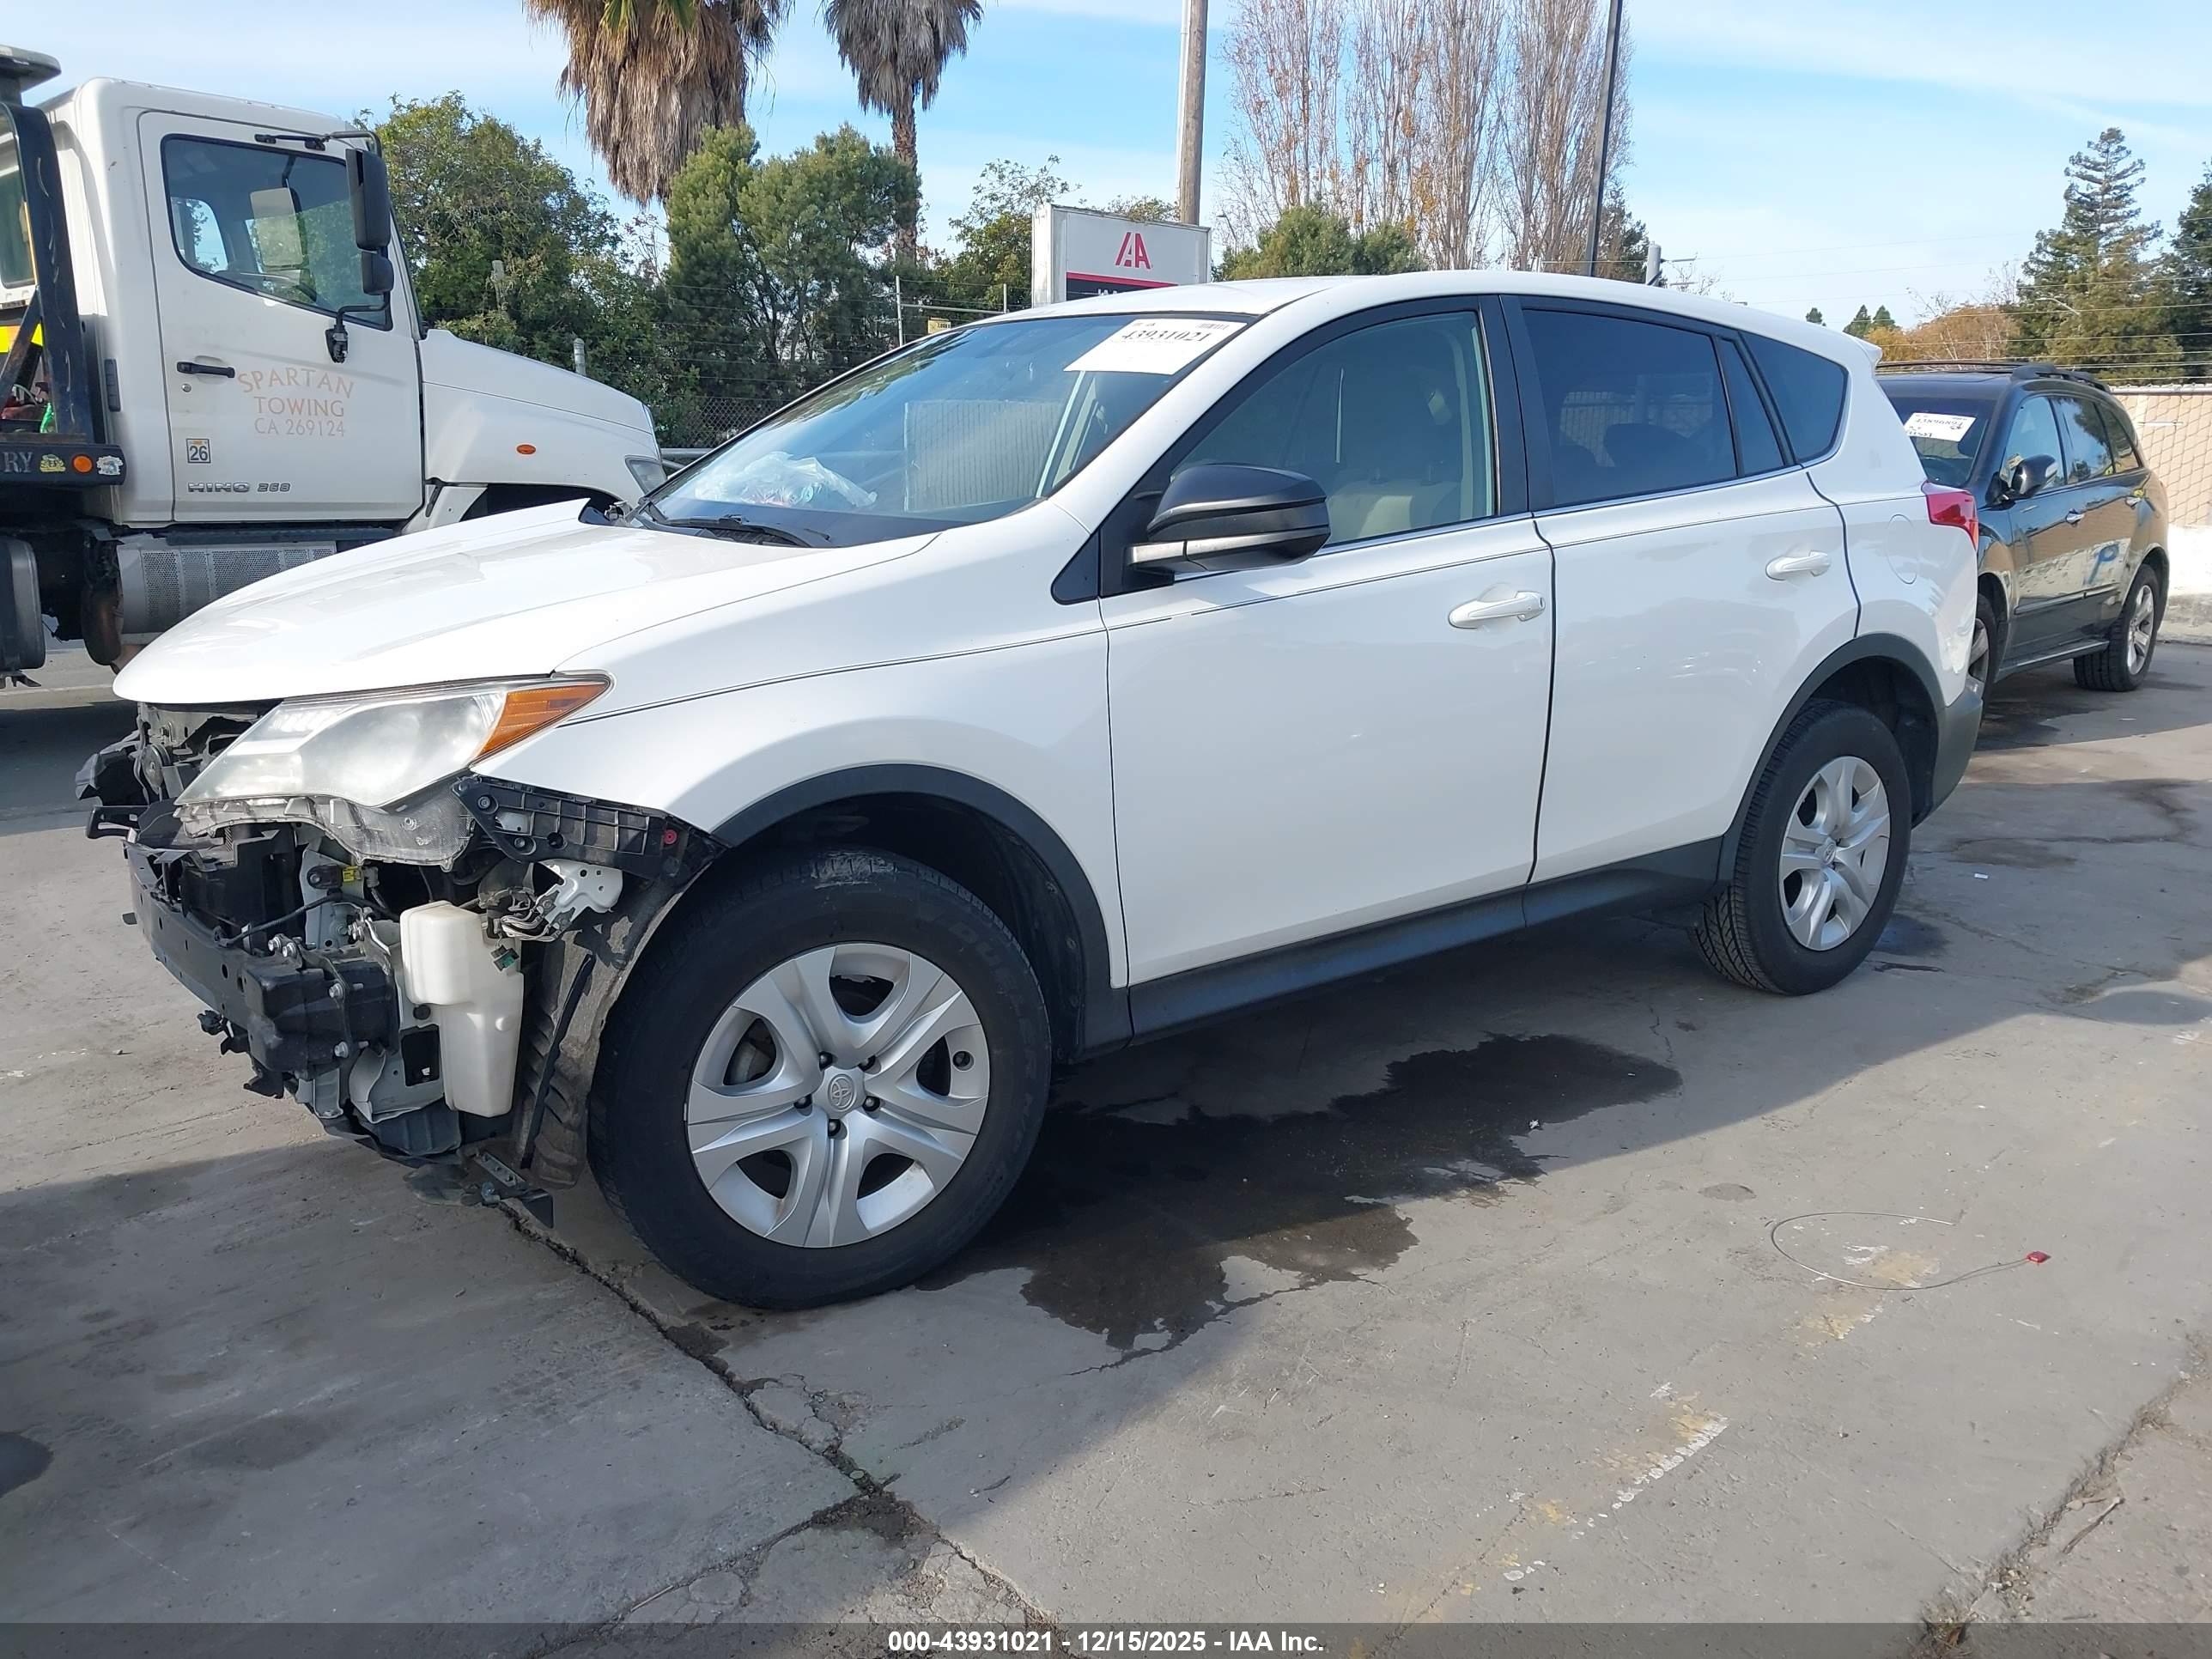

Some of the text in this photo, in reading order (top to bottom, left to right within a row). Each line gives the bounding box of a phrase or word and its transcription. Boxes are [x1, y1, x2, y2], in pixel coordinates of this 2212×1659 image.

[1121, 330, 1212, 342] 43931021
[237, 367, 355, 399] SPARTAN
[253, 396, 344, 417] TOWING
[254, 417, 346, 437] CA 269124
[189, 445, 209, 461] 26
[188, 482, 291, 493] HINO 268
